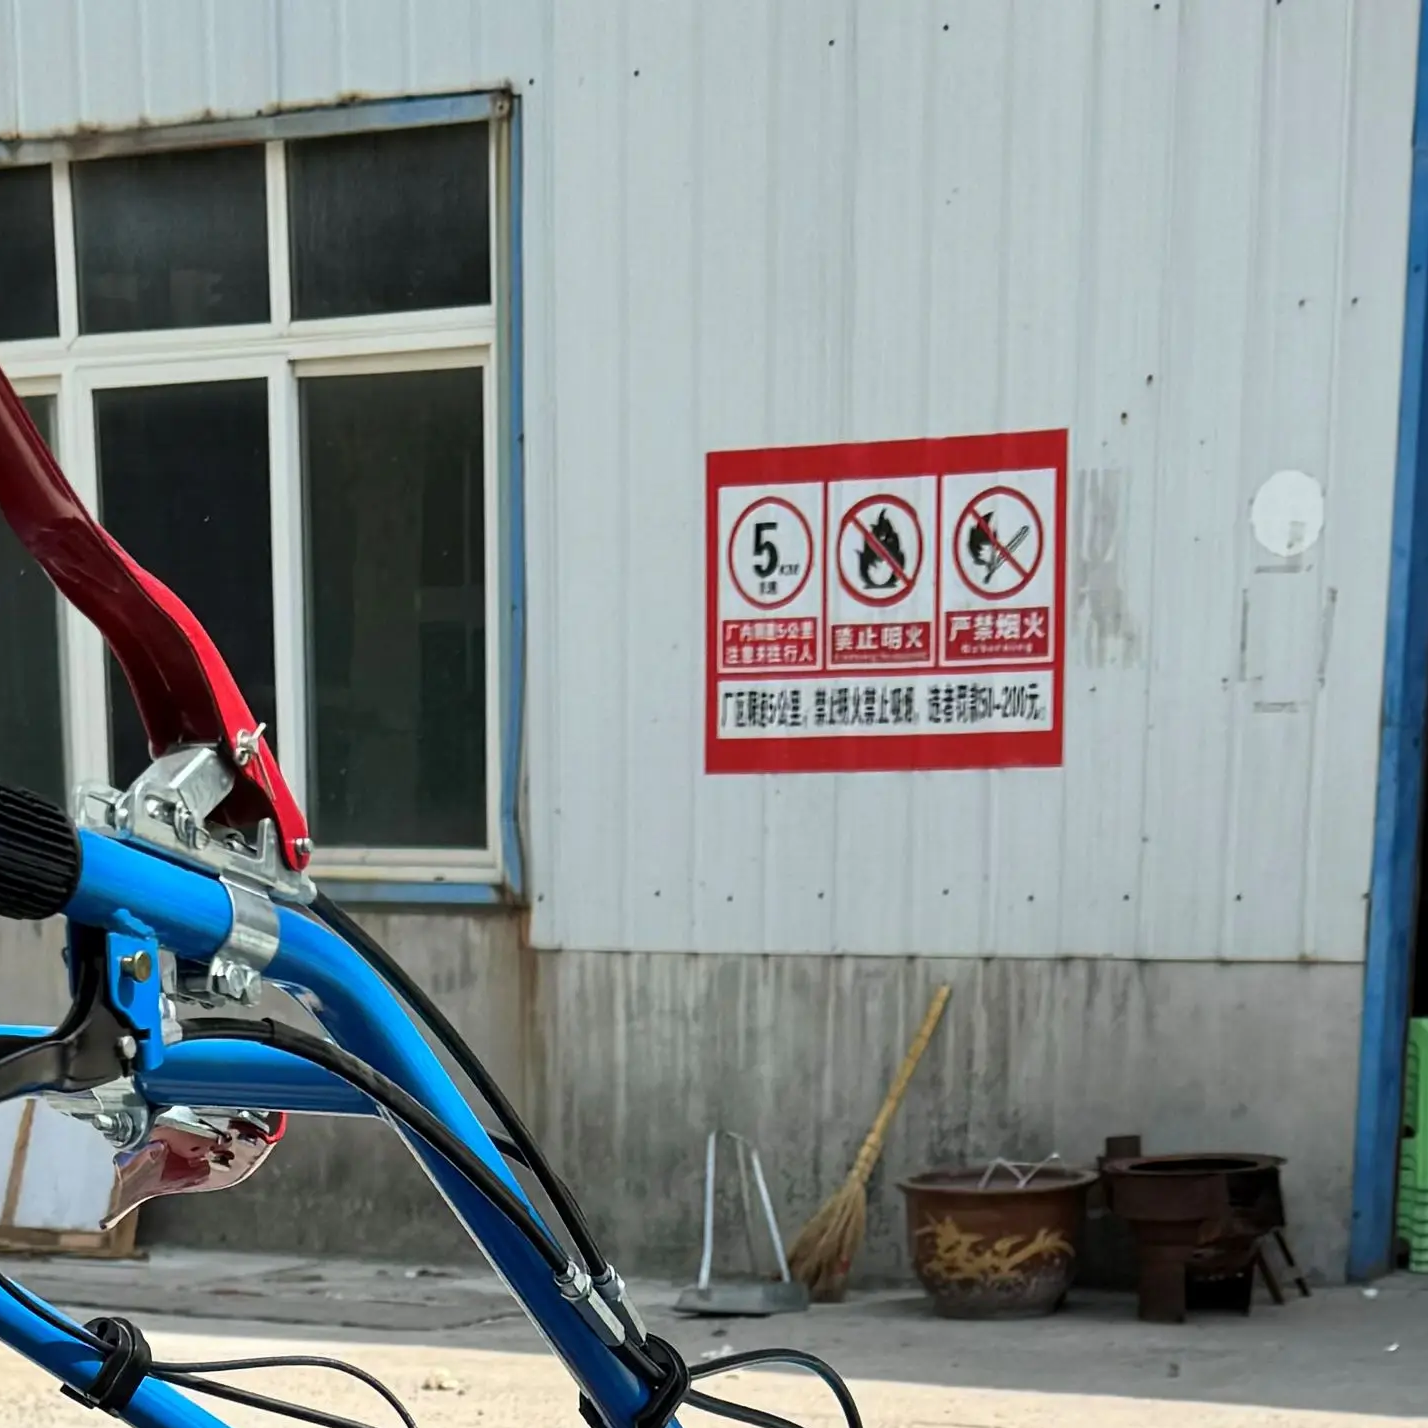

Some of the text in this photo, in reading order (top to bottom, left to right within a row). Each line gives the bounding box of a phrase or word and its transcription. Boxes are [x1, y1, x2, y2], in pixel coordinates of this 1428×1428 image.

[753, 522, 779, 578] 5
[834, 624, 923, 651] 禁止明火
[948, 611, 1045, 642] 严禁烟火
